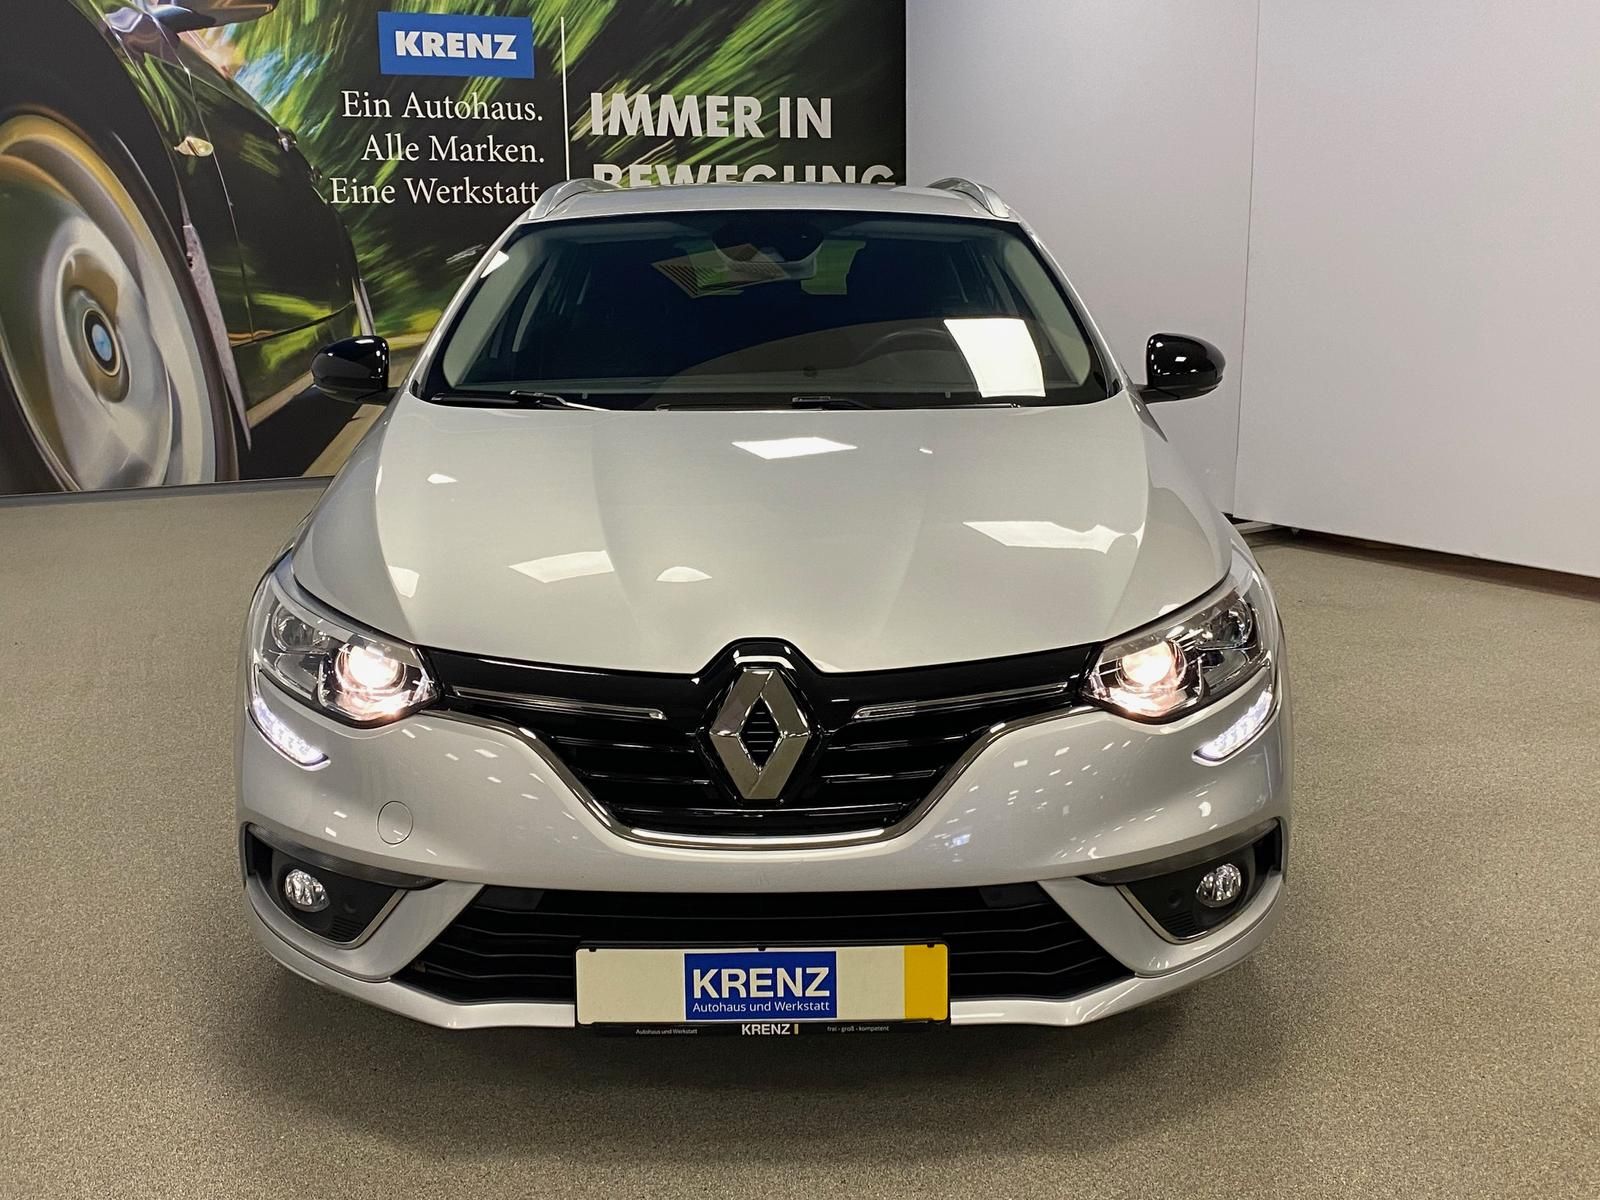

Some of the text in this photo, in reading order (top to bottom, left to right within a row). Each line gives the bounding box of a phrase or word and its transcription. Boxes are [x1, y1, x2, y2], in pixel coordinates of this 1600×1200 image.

[395, 30, 517, 60] KRENZ
[341, 90, 543, 121] Ein Autohaus.
[590, 92, 832, 139] IMMER IN
[361, 133, 545, 163] Alle Marken.
[329, 177, 396, 204] Eine
[693, 967, 830, 998] KRENZ
[692, 1001, 830, 1012] Autohaus und Werkstatt
[741, 1023, 791, 1035] KRENZ
